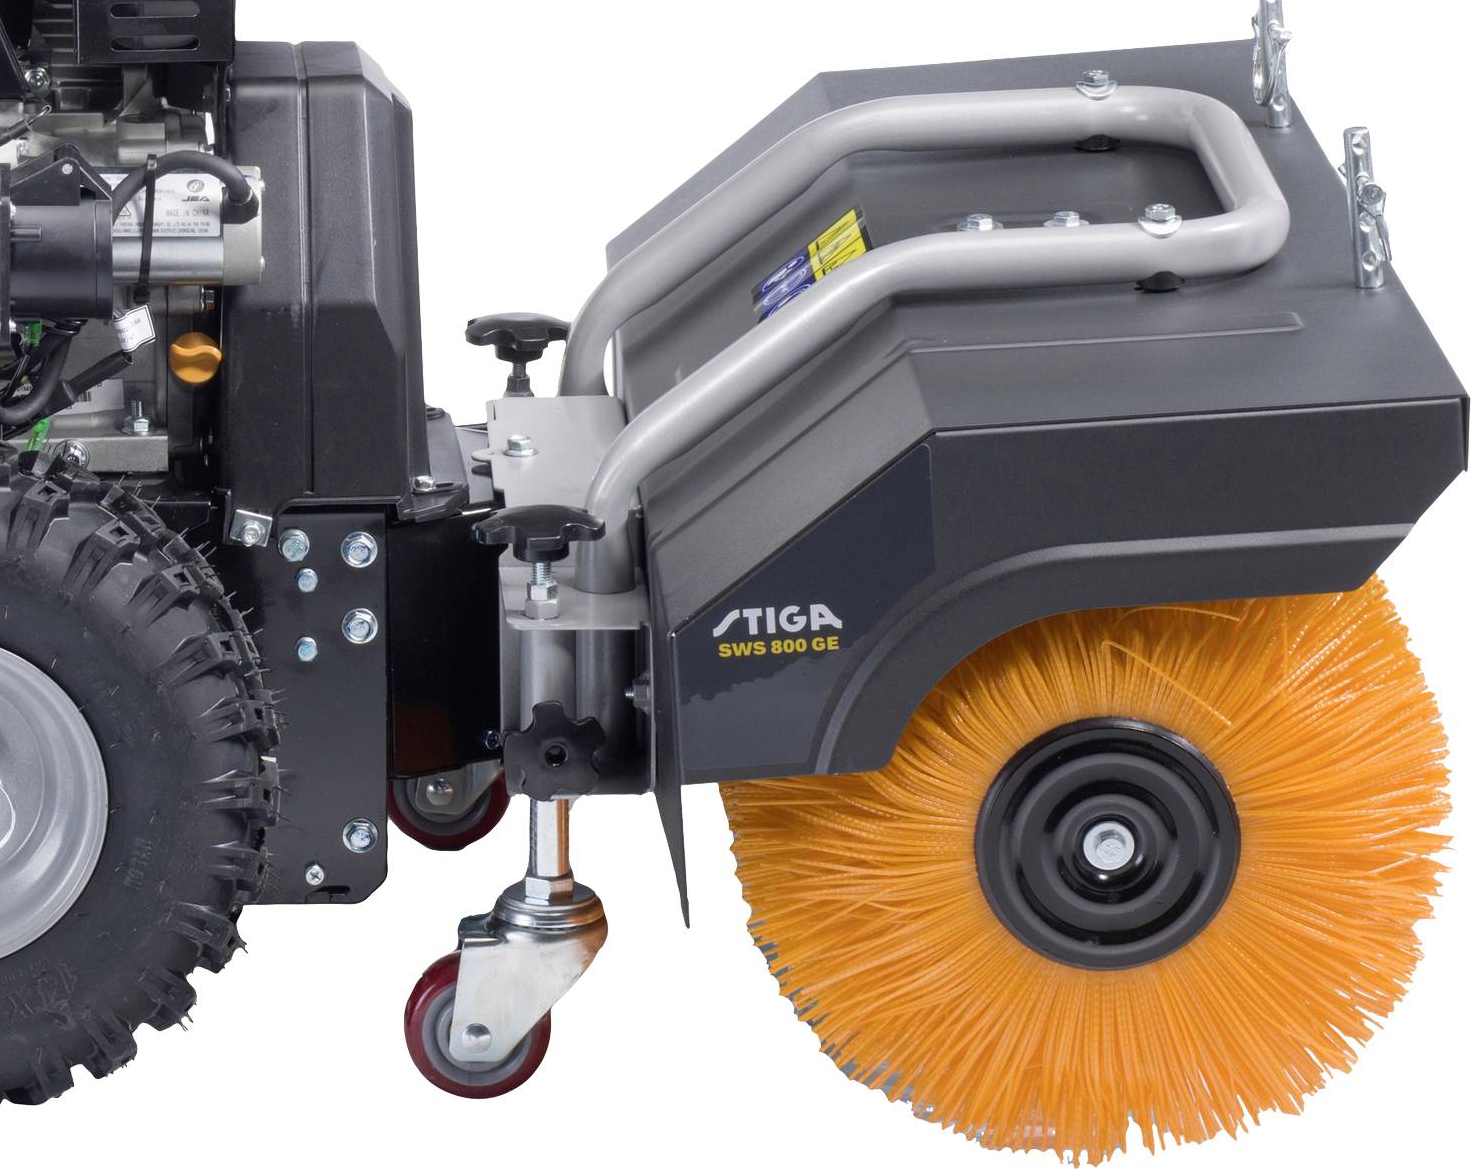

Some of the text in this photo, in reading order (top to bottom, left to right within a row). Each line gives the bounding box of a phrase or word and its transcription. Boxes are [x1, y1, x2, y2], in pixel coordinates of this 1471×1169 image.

[712, 603, 843, 637] STIGA
[718, 636, 840, 658] SWS 800 GE
